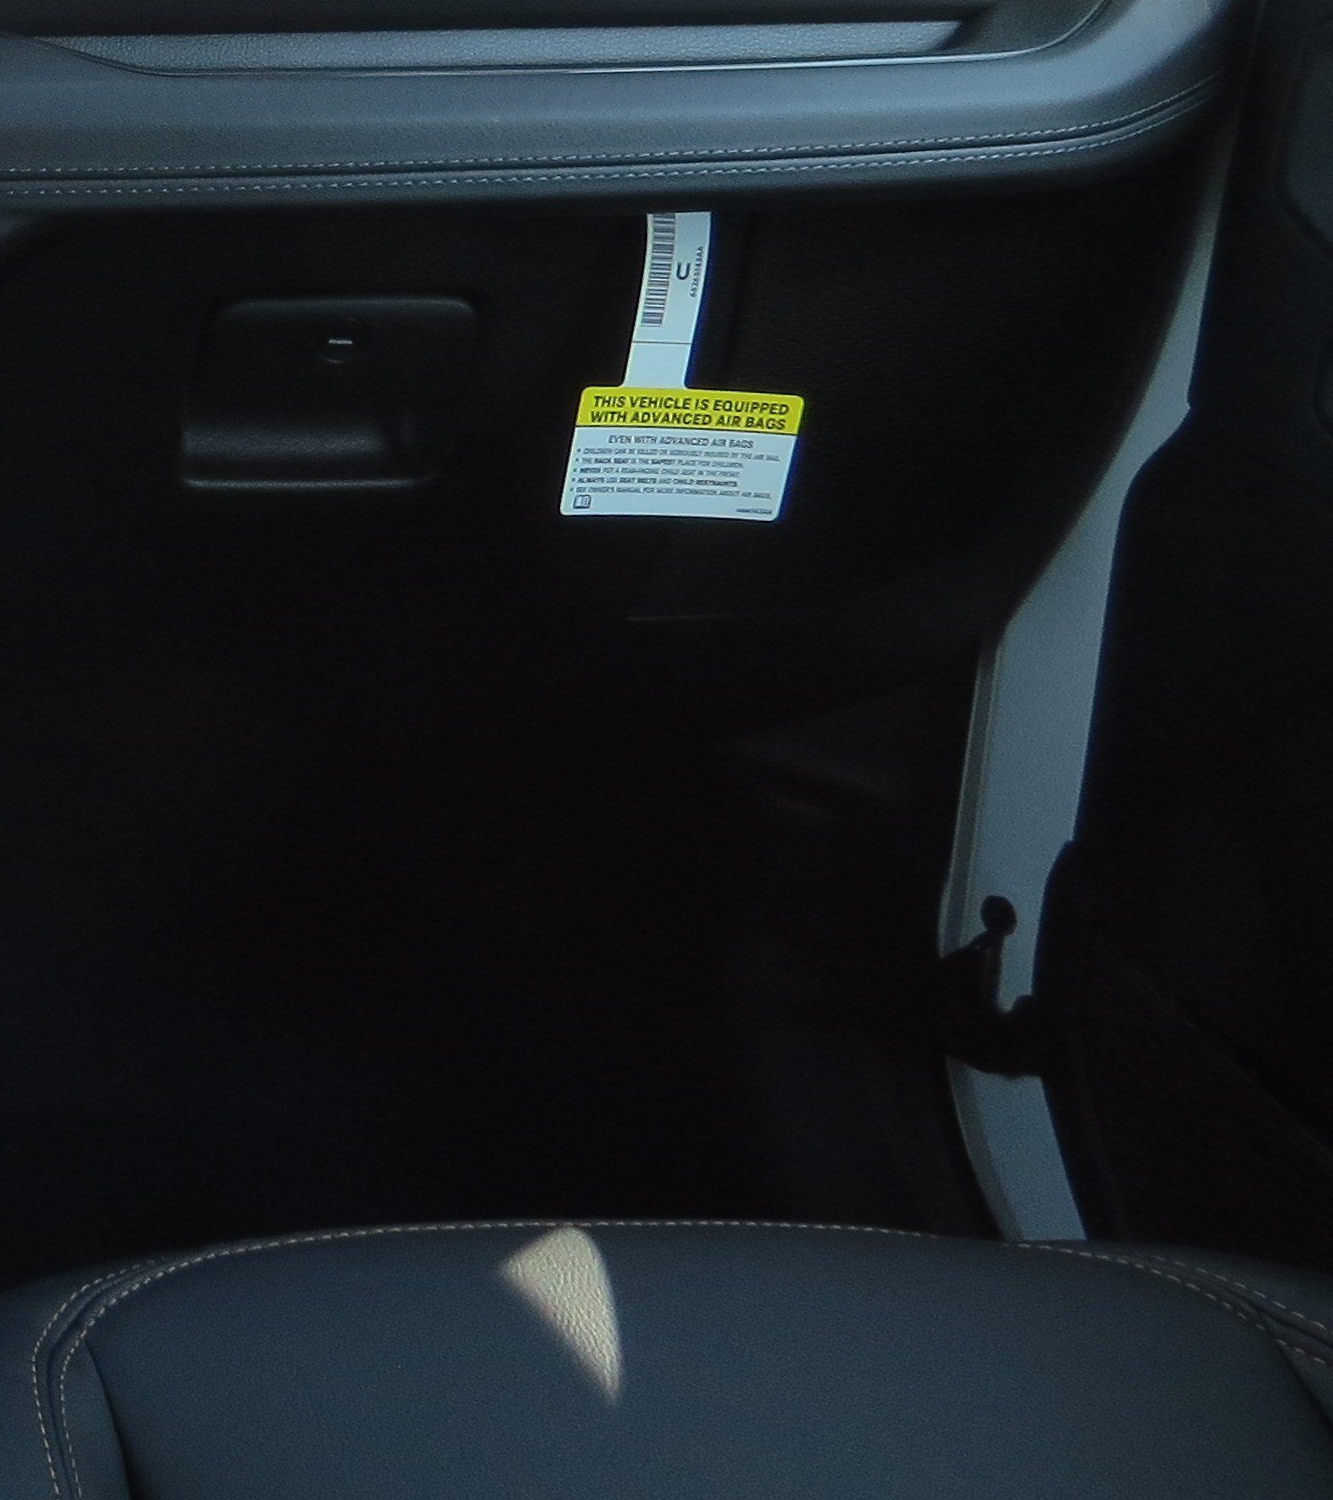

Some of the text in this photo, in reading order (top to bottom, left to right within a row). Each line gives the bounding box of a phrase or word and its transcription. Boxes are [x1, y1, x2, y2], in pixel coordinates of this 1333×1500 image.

[676, 261, 691, 281] U
[593, 395, 790, 416] THIS VEHICLE IS EQUIPPED
[590, 410, 787, 431] WITH ADVANCED AIR BAGS
[608, 434, 754, 449] EVEN WITH ADVANCED AIR BAGS
